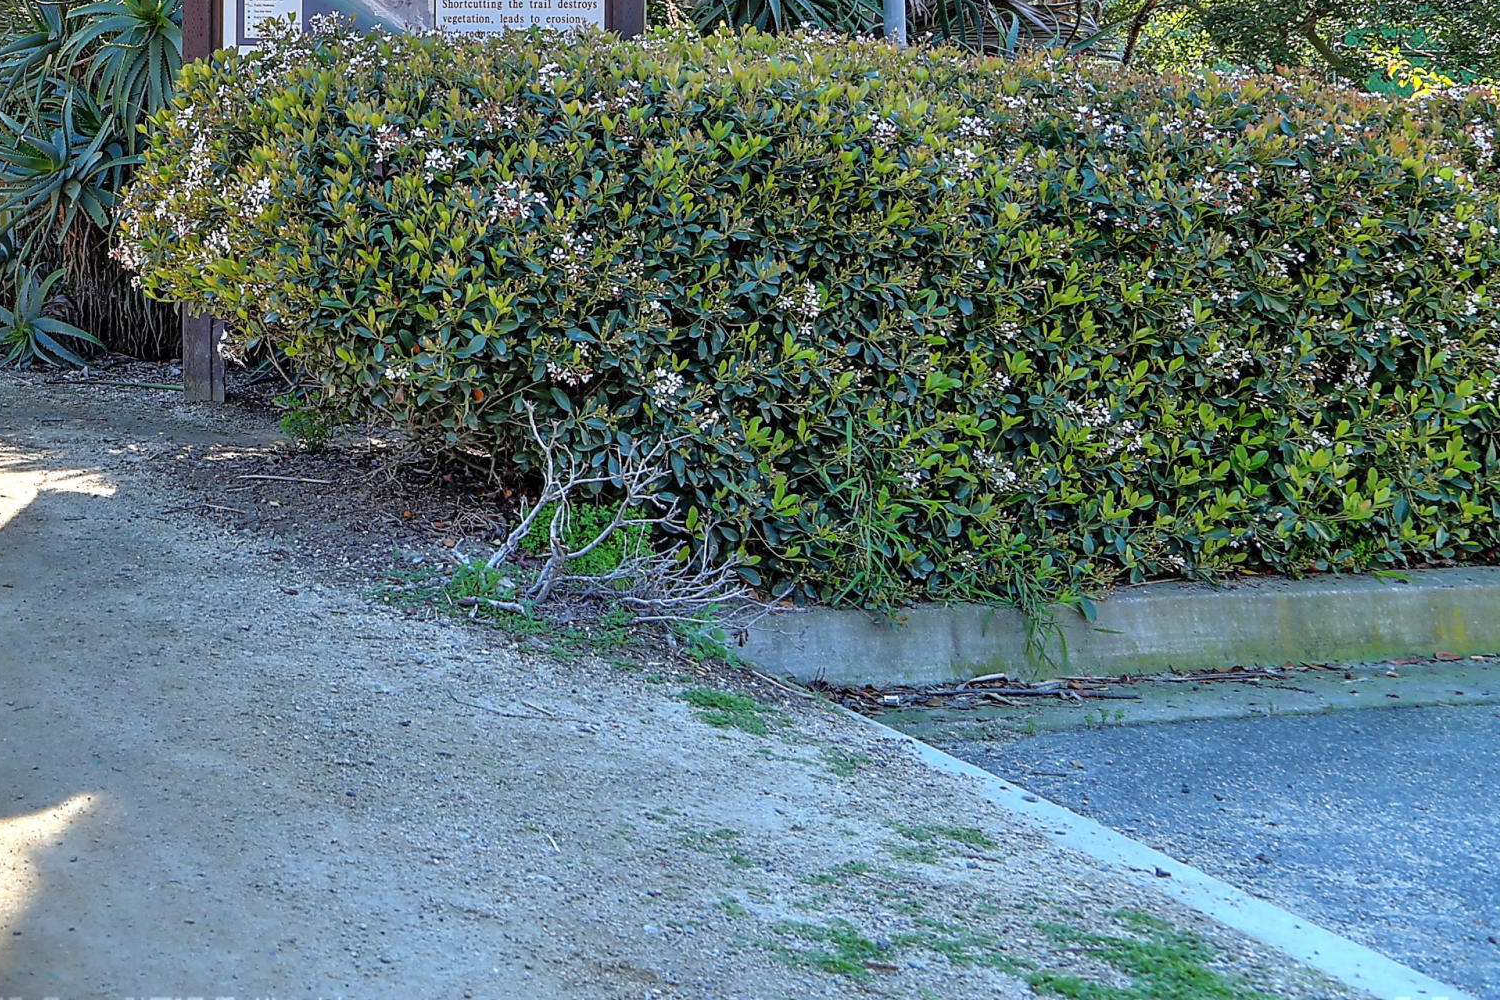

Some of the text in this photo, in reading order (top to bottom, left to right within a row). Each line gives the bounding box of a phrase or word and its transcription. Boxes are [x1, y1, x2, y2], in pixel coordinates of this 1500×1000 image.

[442, 0, 598, 11] Shortcutting the trail destroys
[442, 14, 494, 25] vegetation,
[500, 14, 525, 23] leads
[531, 14, 540, 23] to
